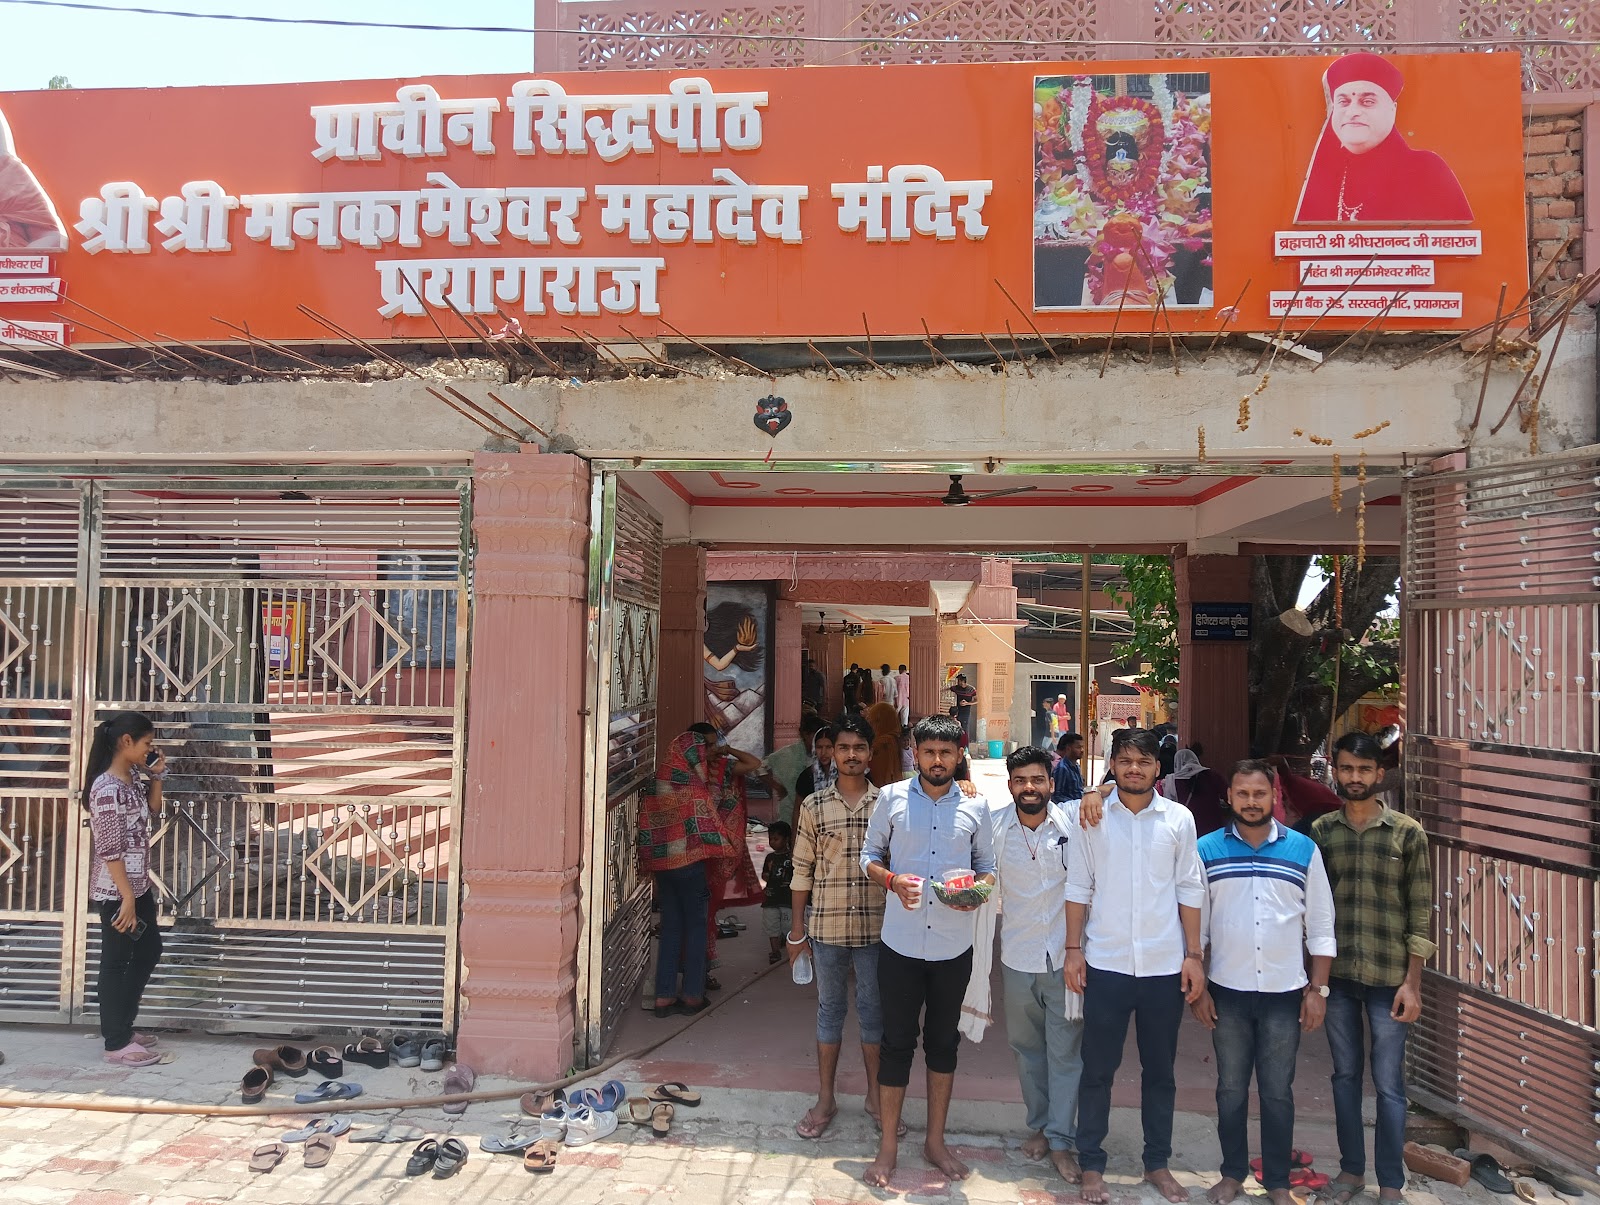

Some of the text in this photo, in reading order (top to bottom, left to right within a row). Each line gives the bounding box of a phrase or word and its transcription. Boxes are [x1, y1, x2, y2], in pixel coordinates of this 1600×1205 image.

[310, 77, 768, 162] प्राचीन सिद्धपीठ
[73, 164, 992, 256] श्री श्री मनकामेश्वर महादेव मंदिर
[1279, 233, 1477, 251] ब्रह्मचारी श्री श्रीधरानन्द जी महाराज
[30, 257, 43, 269] एवं
[1330, 265, 1343, 277] श्री
[1345, 265, 1403, 277] मनकामेश्वर
[1404, 264, 1431, 277] मंदिर
[375, 257, 665, 319] प्रयागराज
[1348, 296, 1387, 309] सरस्वती
[1413, 299, 1459, 310] प्रयागराज
